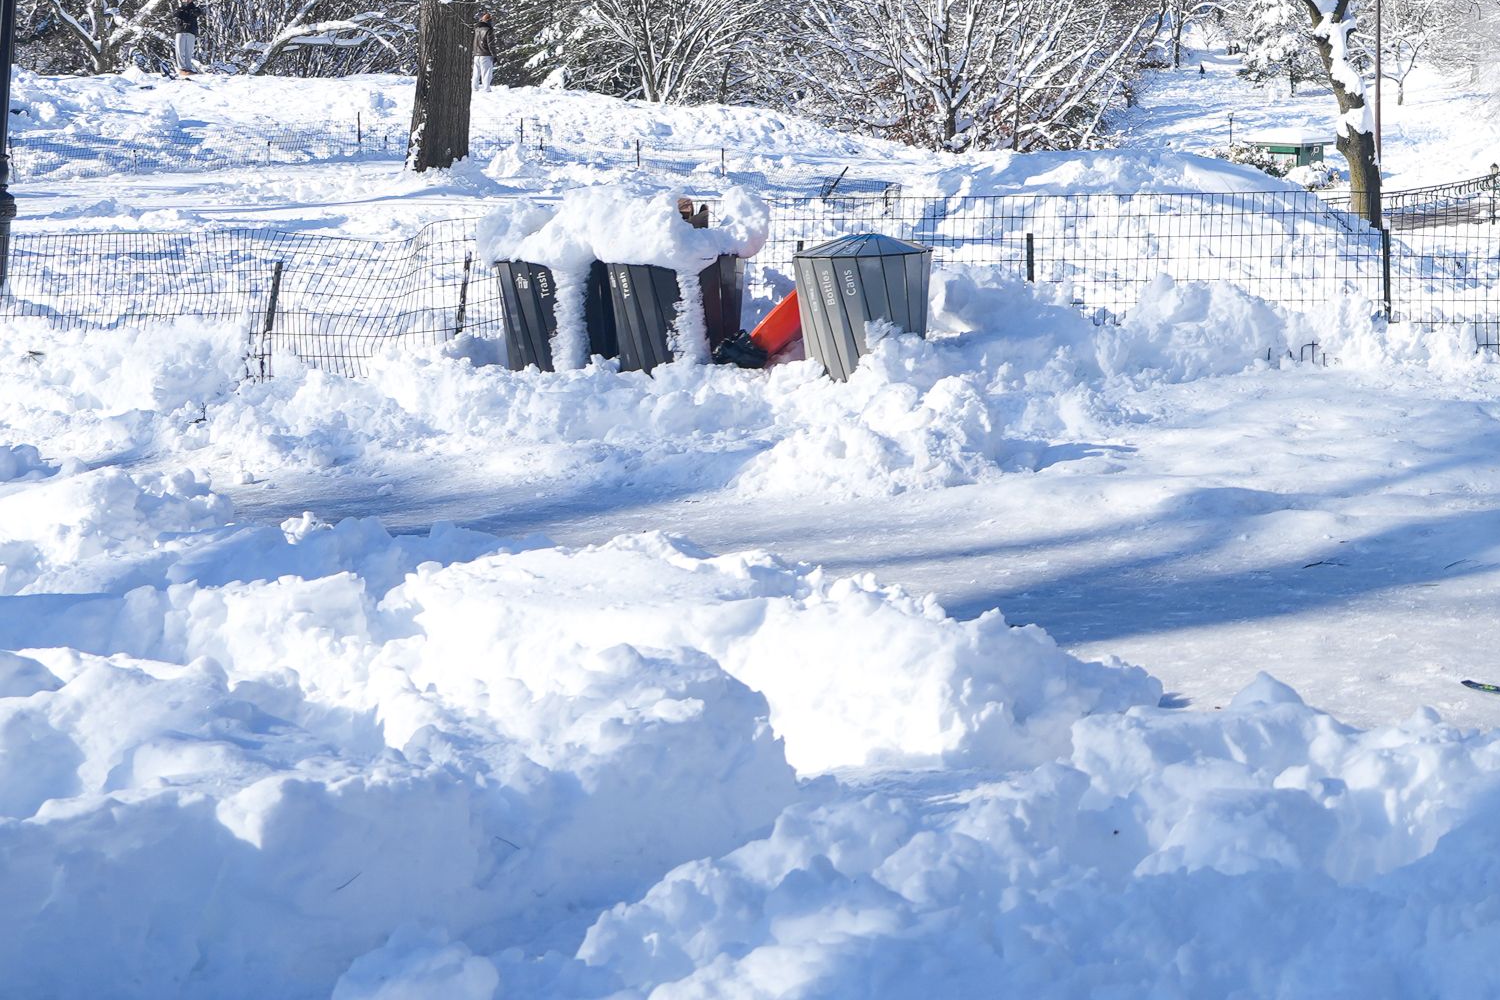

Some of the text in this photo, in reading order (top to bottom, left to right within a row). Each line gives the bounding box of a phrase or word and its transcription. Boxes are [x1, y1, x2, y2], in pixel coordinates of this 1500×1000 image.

[537, 271, 550, 299] Trash
[619, 271, 631, 299] Trash
[822, 270, 836, 306] Bottles
[843, 269, 856, 296] Cans
